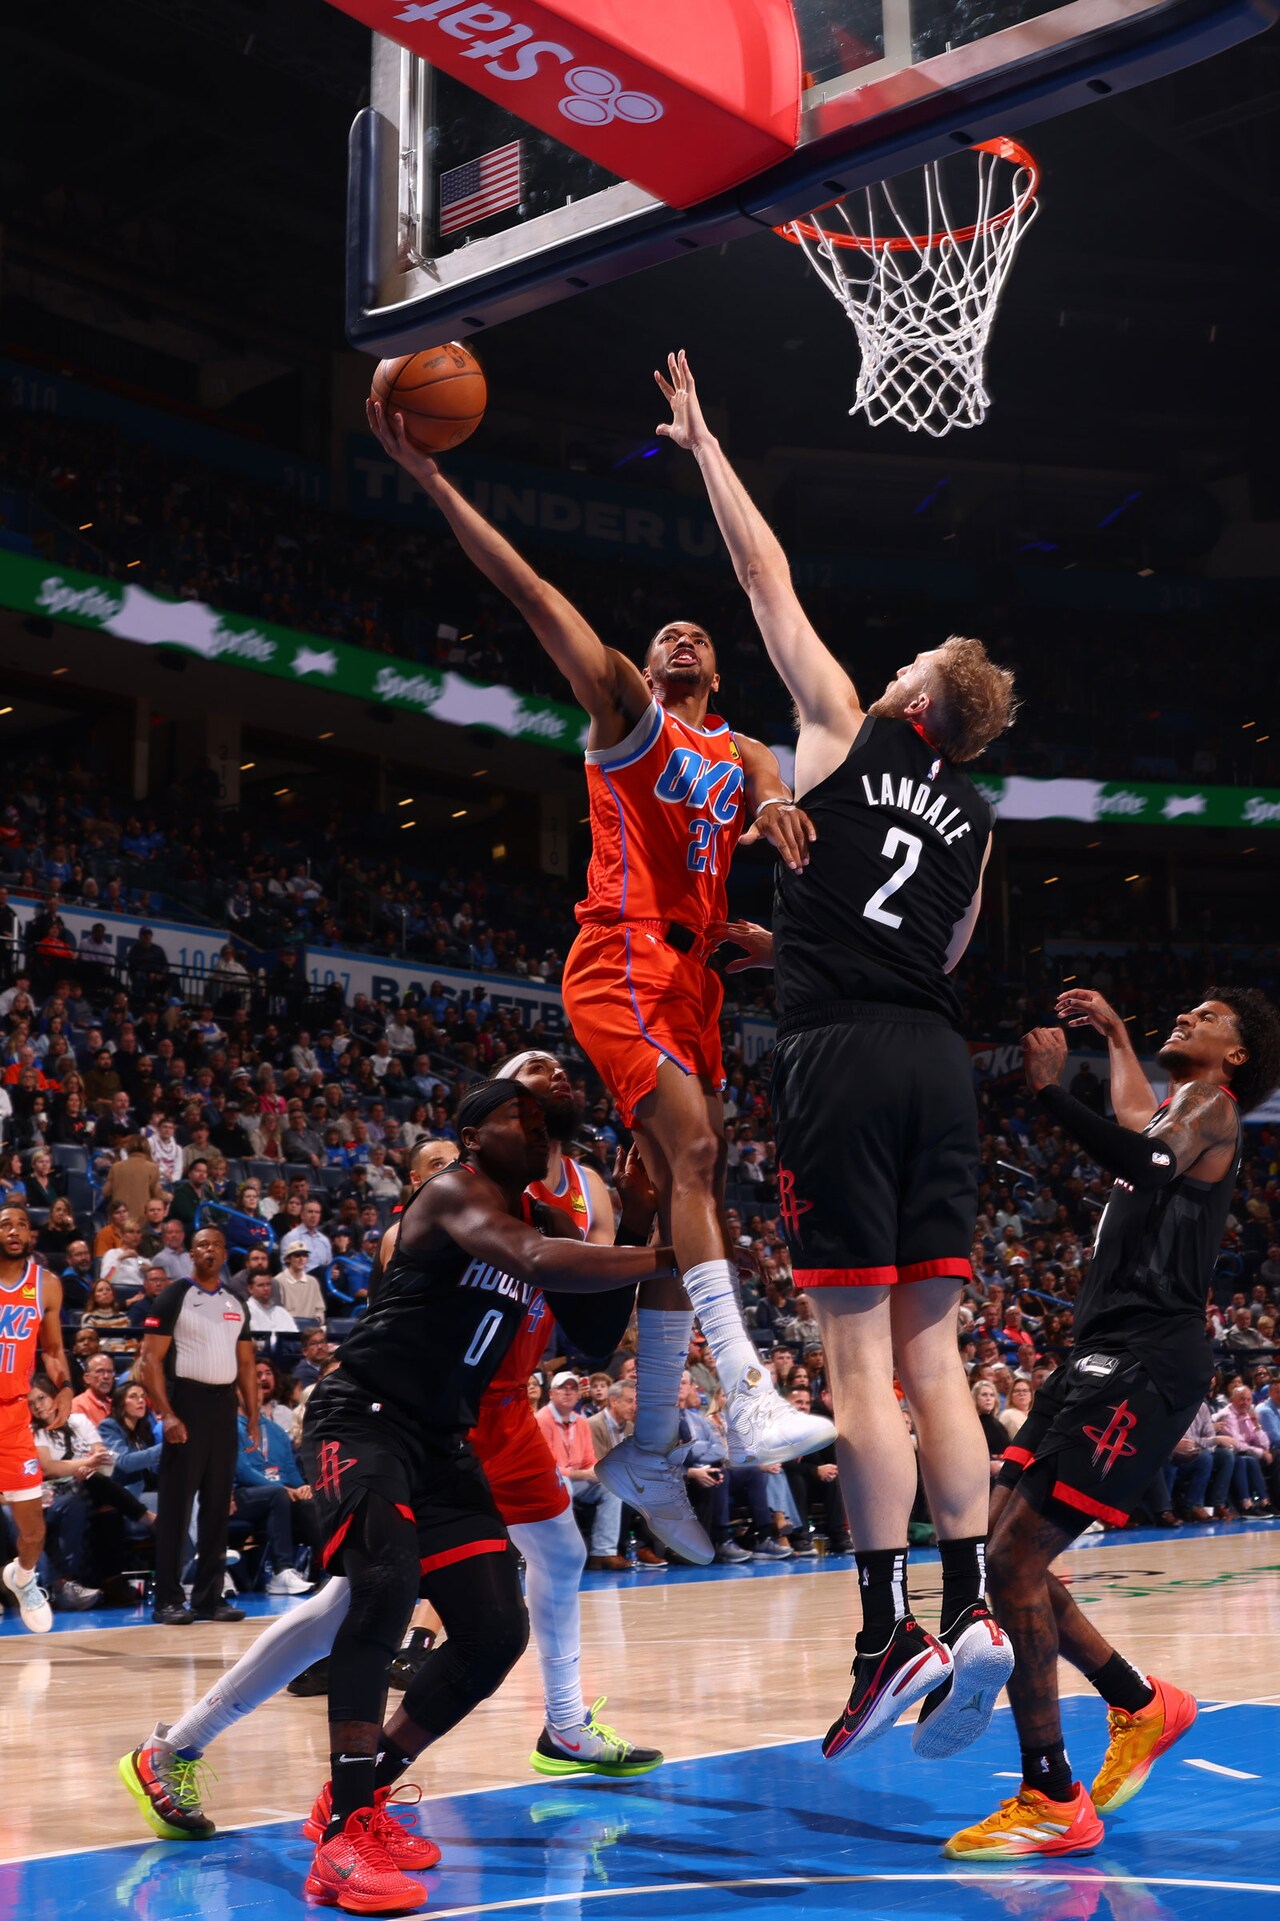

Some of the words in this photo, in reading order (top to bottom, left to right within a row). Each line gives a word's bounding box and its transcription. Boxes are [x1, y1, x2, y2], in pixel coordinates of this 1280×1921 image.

[393, 0, 576, 81] Stat
[676, 516, 728, 560] U
[370, 666, 443, 706] Sprite
[654, 747, 744, 824] OKC
[862, 773, 971, 846] LANDALE
[863, 826, 923, 929] 2
[0, 1304, 37, 1341] KC
[463, 1308, 504, 1367] 0
